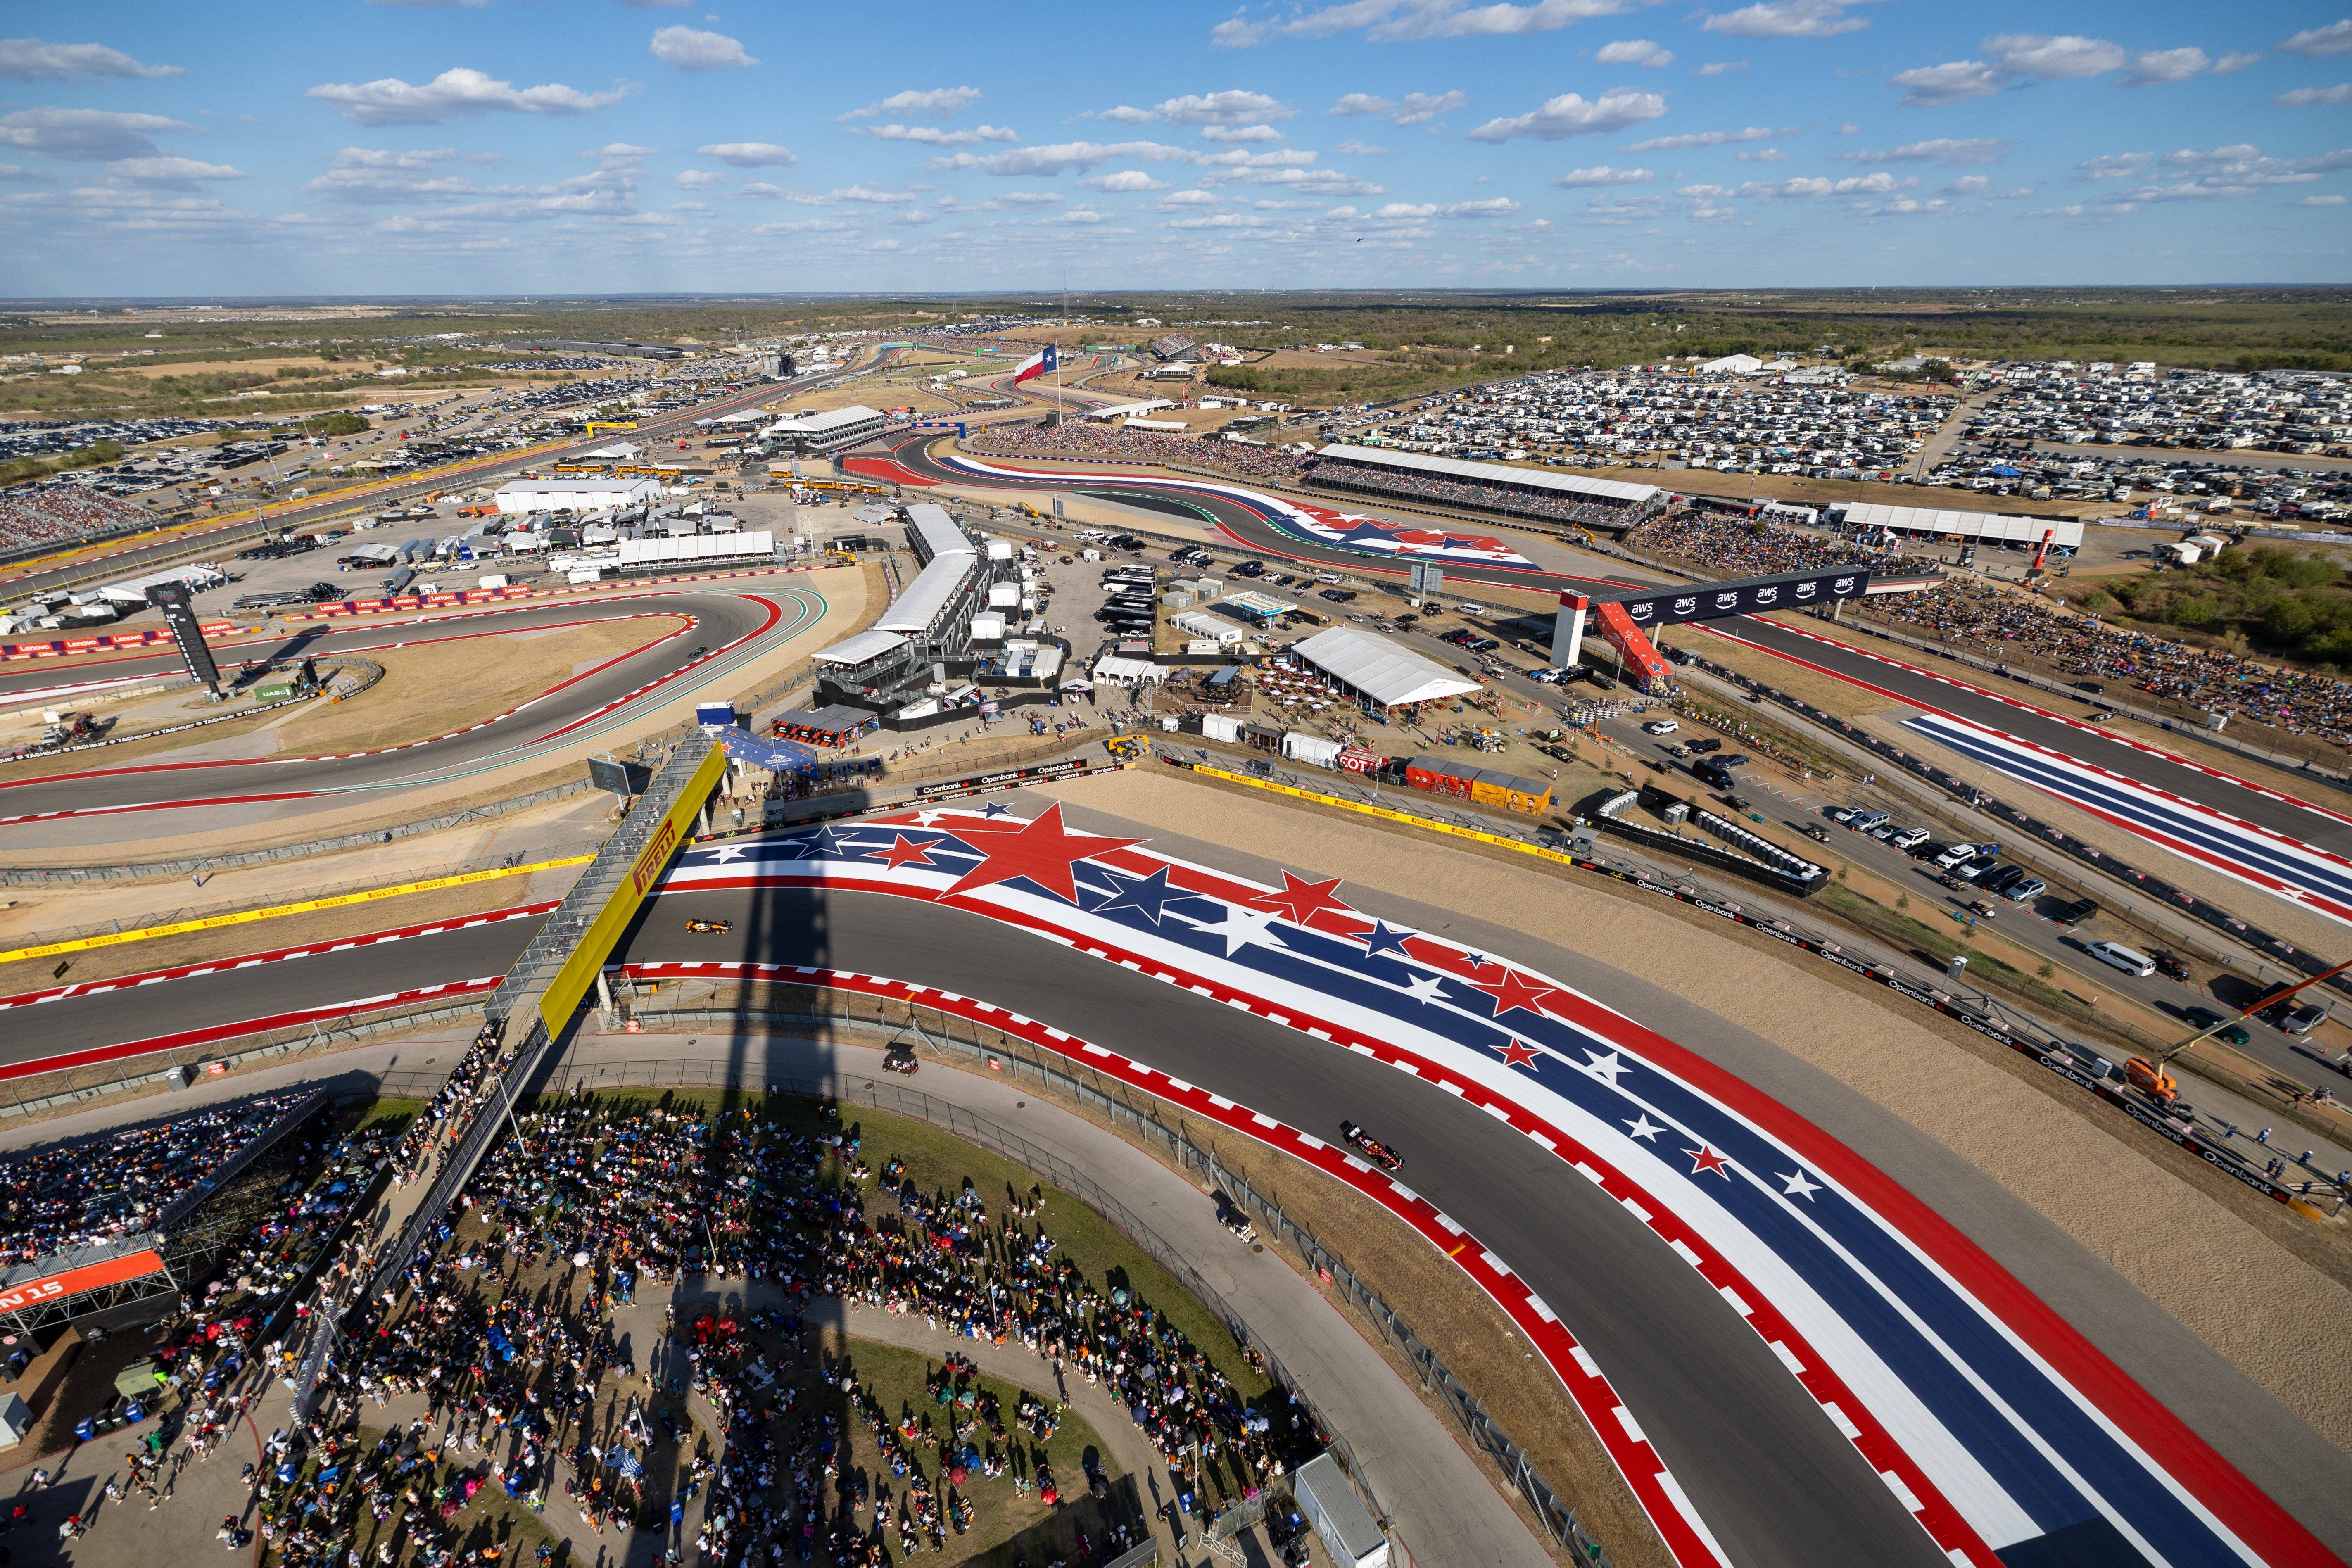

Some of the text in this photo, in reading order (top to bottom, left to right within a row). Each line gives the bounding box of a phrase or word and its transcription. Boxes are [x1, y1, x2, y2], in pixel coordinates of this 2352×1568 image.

[67, 639, 97, 647] Lenovo
[1904, 640, 1924, 651] VUITTON
[1971, 661, 1994, 673] VUITTON
[2028, 681, 2072, 699] LOUIS VUITTON
[2112, 708, 2162, 727] LOUIS VUITTON
[1038, 763, 1073, 774] Openbank
[1199, 767, 1218, 775] PIRELLI
[982, 772, 1018, 783] Openbank
[1231, 775, 1251, 784] PIRELLI
[923, 782, 962, 794] Openbank
[1265, 783, 1285, 791] PIRELLI
[1300, 791, 1321, 800] PIRELLI
[862, 805, 889, 814] Openbank
[1335, 800, 1357, 809] PIRELLI
[1373, 808, 1396, 818] PIRELLI
[1412, 817, 1436, 830] PIRELLI
[1452, 827, 1477, 839] PIRELLI
[1494, 837, 1519, 849] PIRELLI
[633, 818, 675, 897] PIRELLI
[1537, 848, 1564, 861] PIRELLI
[549, 859, 573, 868] PIRELLI
[508, 865, 532, 874] PIRELLI
[461, 872, 491, 883] PIRELLI
[415, 880, 446, 890] PIRELLI
[1637, 879, 1675, 898] Openbank
[368, 888, 399, 898] PIRELLI
[315, 898, 347, 908] PIRELLI
[259, 907, 292, 917] PIRELLI
[1696, 899, 1735, 919] Openbank
[203, 916, 237, 927] PIRELLI
[145, 926, 180, 936] PIRELLI
[1756, 922, 1798, 945] Openbank
[85, 936, 121, 946] PIRELLI
[24, 946, 61, 957] PIRELLI
[1820, 949, 1865, 973] Openbank
[1889, 979, 1936, 1007] Openbank
[1961, 1014, 2012, 1046] Openbank
[2040, 1055, 2095, 1091] Openbank
[2125, 1103, 2183, 1145] Openbank
[2204, 1151, 2272, 1196] Openbank
[0, 1281, 64, 1309] N 15
